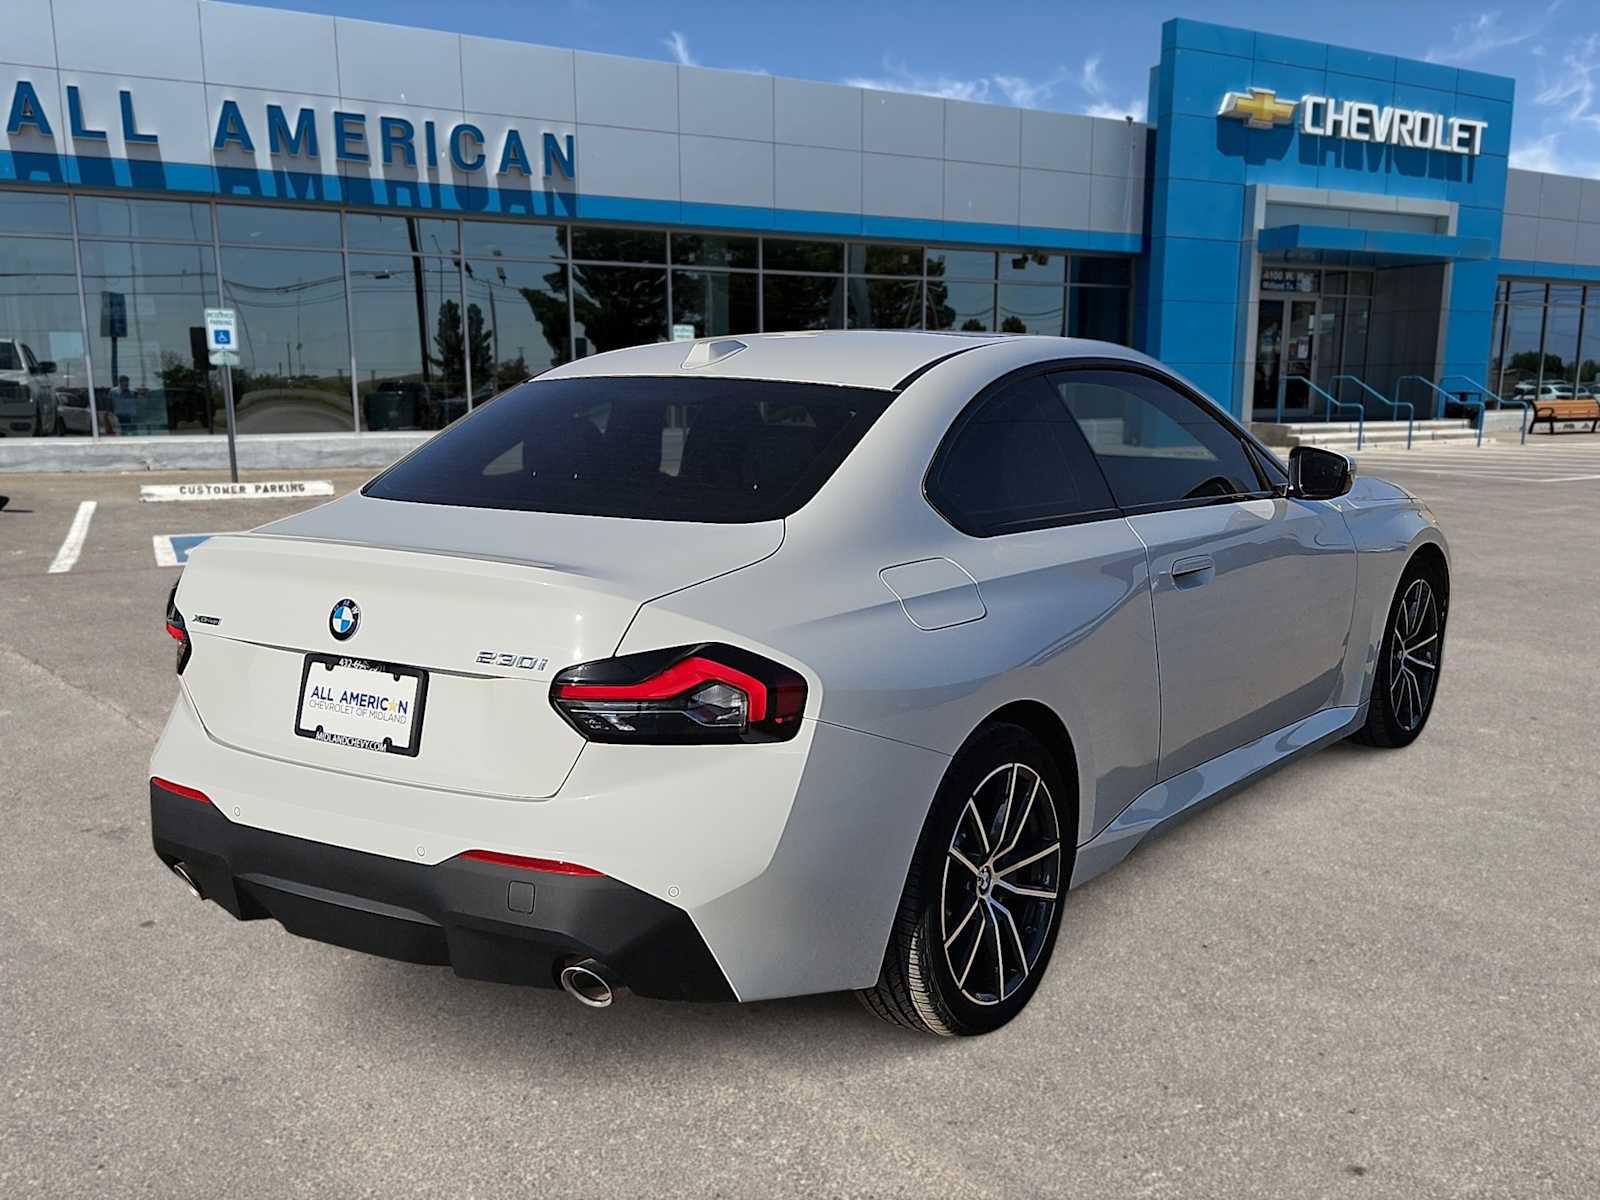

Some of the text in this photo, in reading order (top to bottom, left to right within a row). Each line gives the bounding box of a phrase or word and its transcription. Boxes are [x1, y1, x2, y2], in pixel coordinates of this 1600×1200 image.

[7, 81, 575, 180] ALL AMERICAN
[1301, 94, 1488, 155] CHEVROLET
[179, 482, 305, 496] CUSTOMER PARKING
[476, 651, 549, 671] 230i
[310, 685, 334, 701] ALL
[309, 699, 407, 725] CHEVROLET OF MIDLAND
